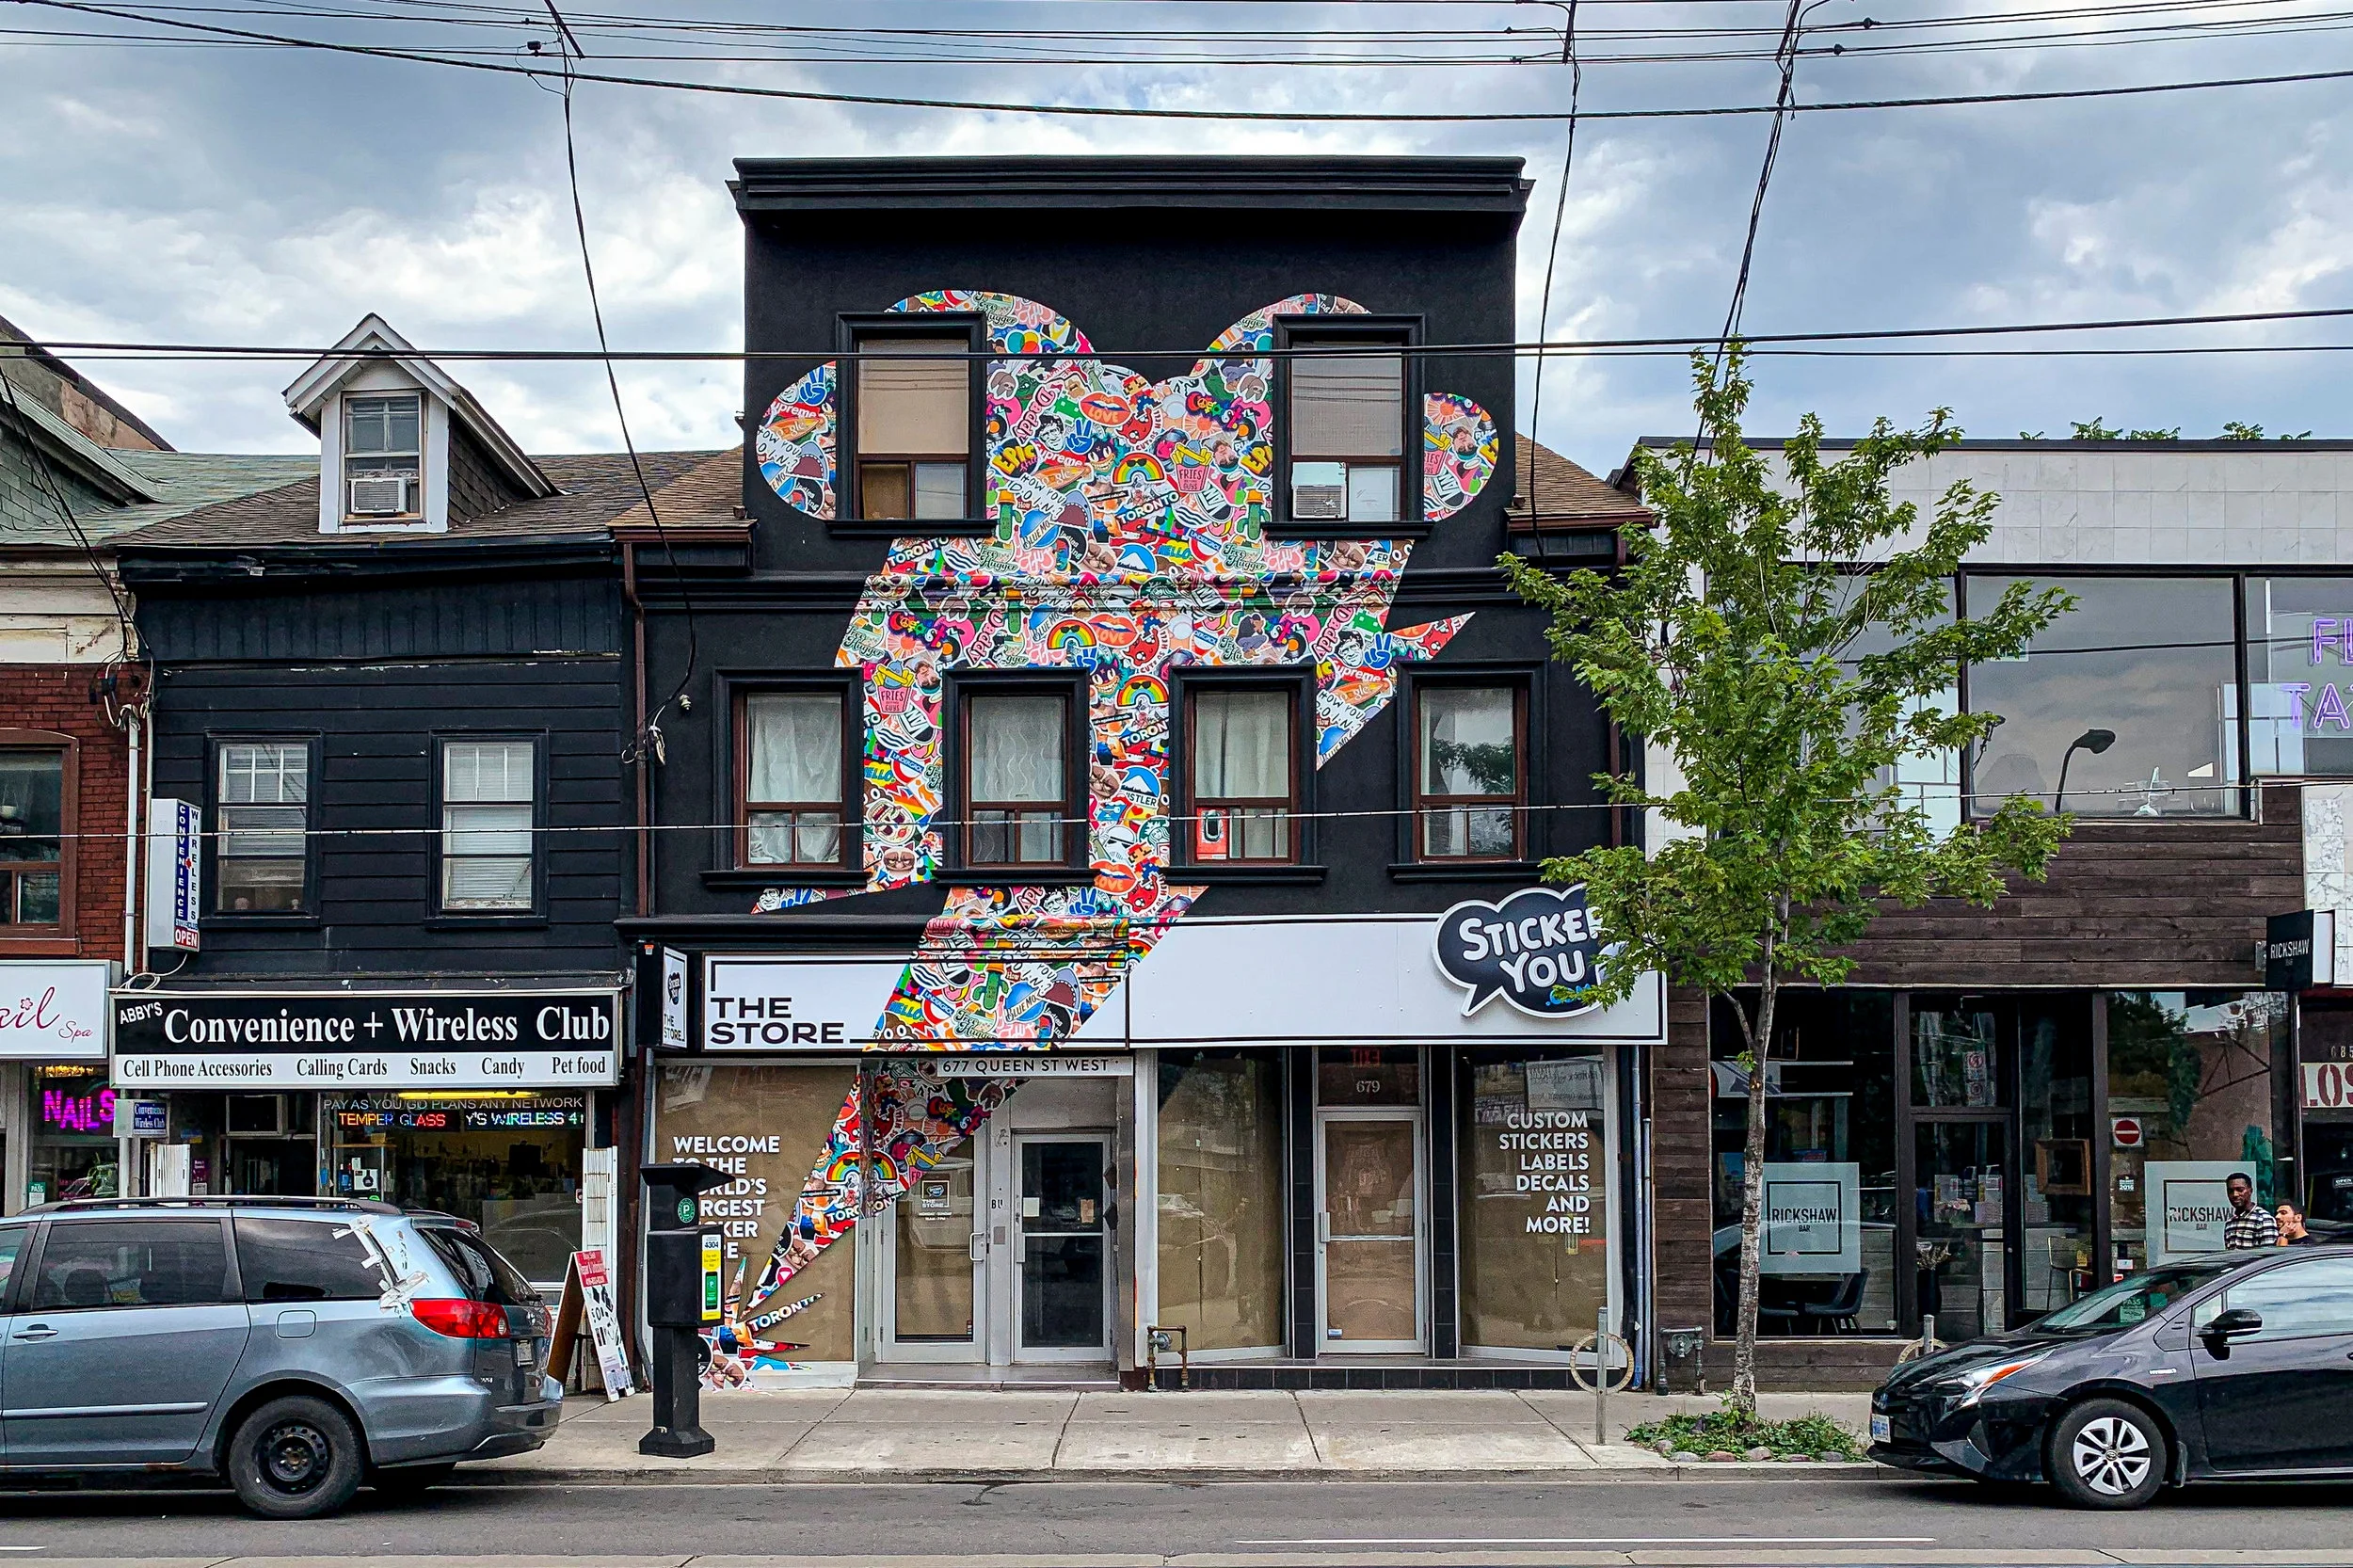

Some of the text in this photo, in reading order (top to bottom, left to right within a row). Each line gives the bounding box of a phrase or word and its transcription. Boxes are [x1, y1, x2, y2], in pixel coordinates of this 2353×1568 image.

[771, 401, 816, 418] upreme
[1088, 408, 1118, 423] LOVE
[992, 445, 1035, 474] EPIC
[1179, 469, 1203, 480] FRIES
[1020, 474, 1045, 492] HOW
[1047, 488, 1067, 506] YOU
[1432, 468, 1460, 502] VAN
[1120, 491, 1179, 524] TORONTO
[1200, 481, 1227, 517] VAN
[1039, 519, 1051, 534] MO
[888, 536, 949, 567] TORONTO
[1223, 543, 1246, 558] Tree
[980, 555, 1018, 571] Hugger
[1226, 554, 1266, 570] Hugger
[1096, 629, 1124, 644] LOVE
[2313, 618, 2353, 664] FL
[844, 636, 883, 657] Hugger
[1005, 655, 1028, 665] gger
[881, 690, 904, 701] FRIES
[1319, 690, 1364, 722] HOW YOU
[2279, 682, 2353, 729] TA
[904, 705, 929, 737] VAN
[1124, 719, 1169, 745] TORON
[177, 805, 186, 918] CONVENIENCE
[190, 809, 200, 920] WIRELESS
[175, 929, 198, 947] OPEN
[2270, 938, 2310, 959] RICKSHAW
[1498, 950, 1586, 993] YOU
[710, 997, 792, 1018] THE
[1025, 994, 1036, 1009] MO
[0, 986, 93, 1043] ail Spa
[120, 1001, 163, 1025] ABBY'S
[664, 1014, 674, 1027] THE
[164, 1008, 355, 1044] Convenience
[392, 1007, 518, 1042] Wireless
[536, 1006, 610, 1041] Club
[664, 1027, 681, 1041] STORE
[710, 1021, 844, 1044] STORE
[123, 1056, 606, 1080] Cell Phone Accessories Calling Cards Snacks Candy Pet food
[942, 1058, 1109, 1075] 677 QUEEN ST WEST
[1356, 1080, 1381, 1093] 679
[44, 1090, 117, 1130] NAILS
[135, 1103, 166, 1115] Convenience
[324, 1096, 584, 1110] PAY AS YOU GO PLANS ANY NETWORK
[135, 1117, 166, 1128] Wireless Club
[339, 1112, 446, 1127] TEMPER GLASS
[491, 1112, 565, 1126] WIRELESS
[1506, 1112, 1588, 1129] CUSTOM
[672, 1135, 780, 1153] WELCOME
[1499, 1132, 1589, 1151] STICKERS
[706, 1158, 747, 1175] THE
[1520, 1153, 1589, 1171] LABELS
[699, 1177, 767, 1195] RLD'S
[1515, 1174, 1590, 1192] DECALS
[700, 1199, 766, 1217] RGEST
[1545, 1195, 1590, 1213] AND
[1770, 1208, 1837, 1223] RICKSHAW
[2169, 1207, 2235, 1223] RICKSHAW
[1526, 1215, 1591, 1234] MORE!
[1799, 1224, 1811, 1233] BAR
[748, 1292, 825, 1332] TORONT
